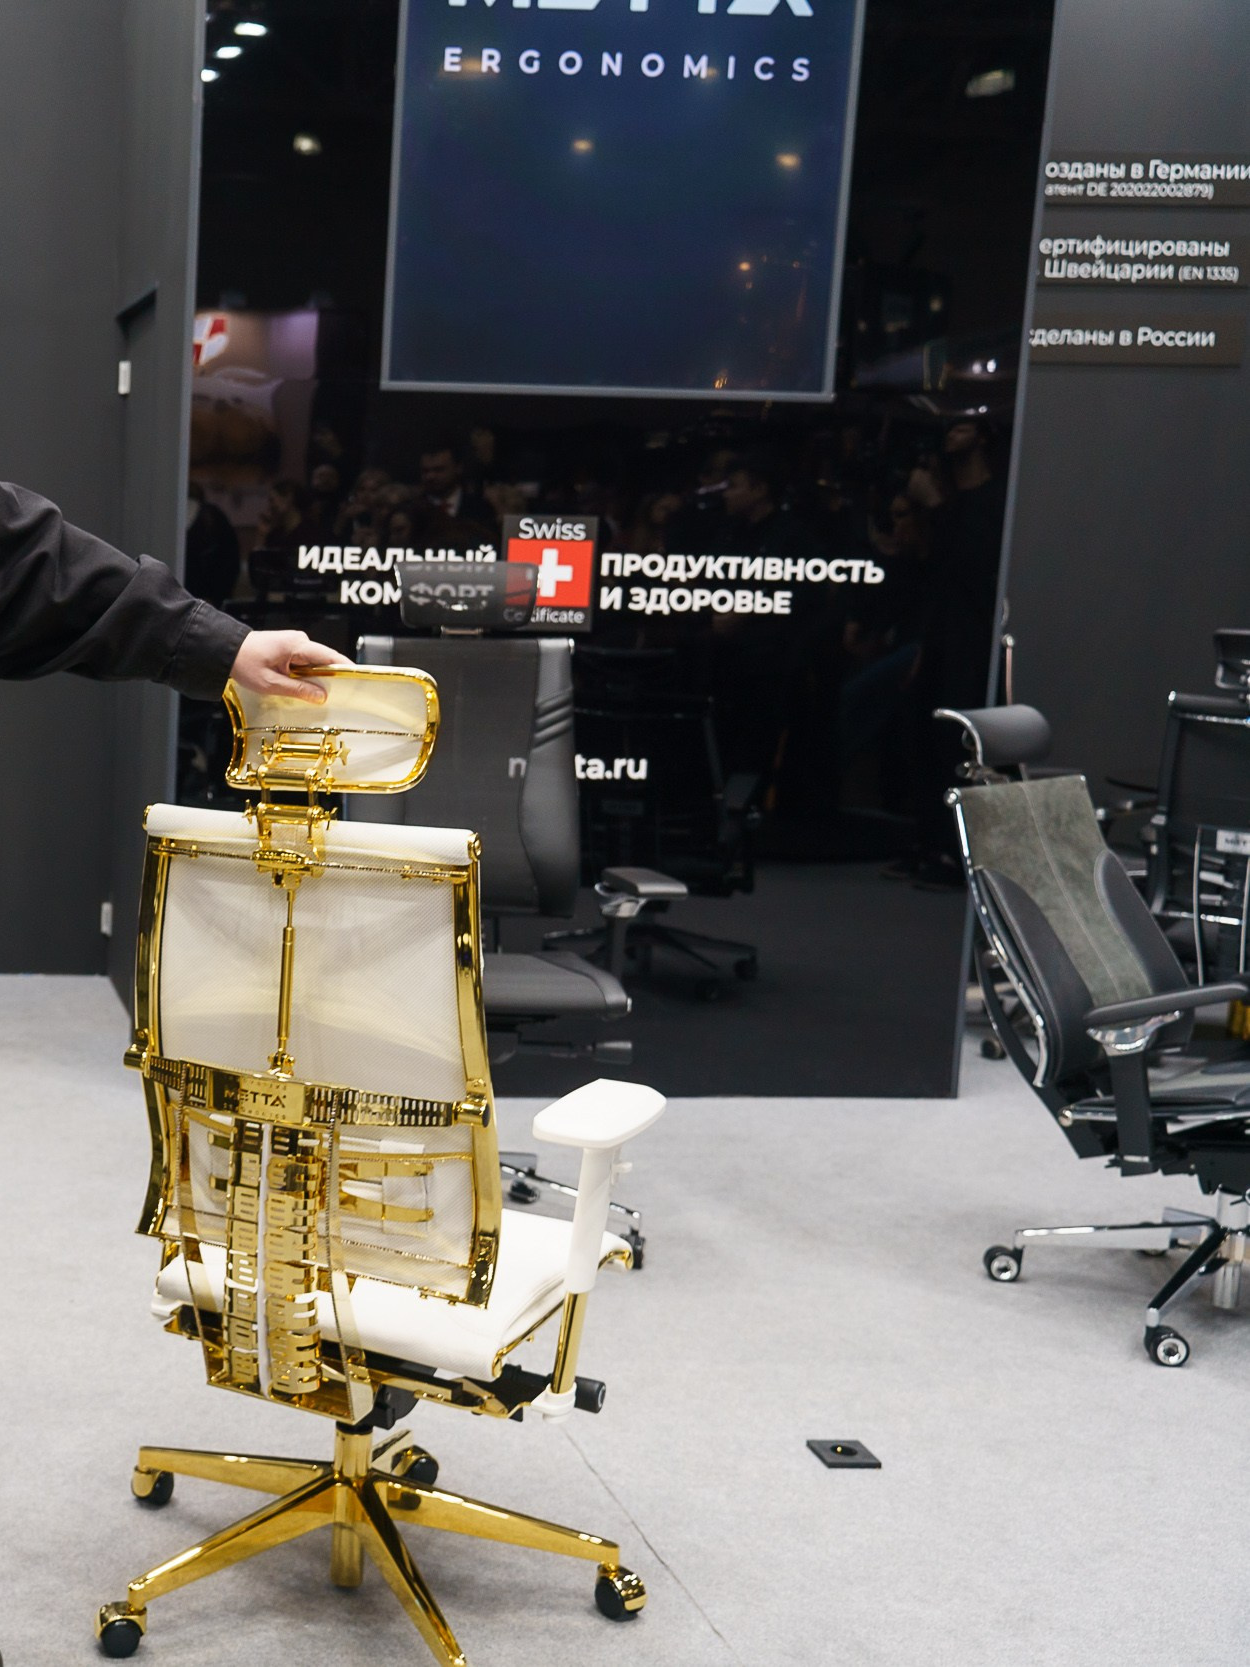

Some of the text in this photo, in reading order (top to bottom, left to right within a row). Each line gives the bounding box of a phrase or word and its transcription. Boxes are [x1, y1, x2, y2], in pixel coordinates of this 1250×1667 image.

[443, 46, 811, 82] ERGONOMICS
[1044, 161, 1126, 181] озданы
[1130, 163, 1144, 179] в
[1044, 184, 1085, 196] атент
[1086, 182, 1109, 197] DE
[1038, 234, 1230, 260] ертифицированы
[1044, 258, 1175, 283] Швейцарии
[1118, 330, 1133, 346] в
[1137, 326, 1216, 347] России
[518, 517, 587, 541] Swiss
[600, 552, 886, 584] ПРОДУКТИВНОСТЬ
[600, 586, 793, 616] И ЗДОРОВЬЕ
